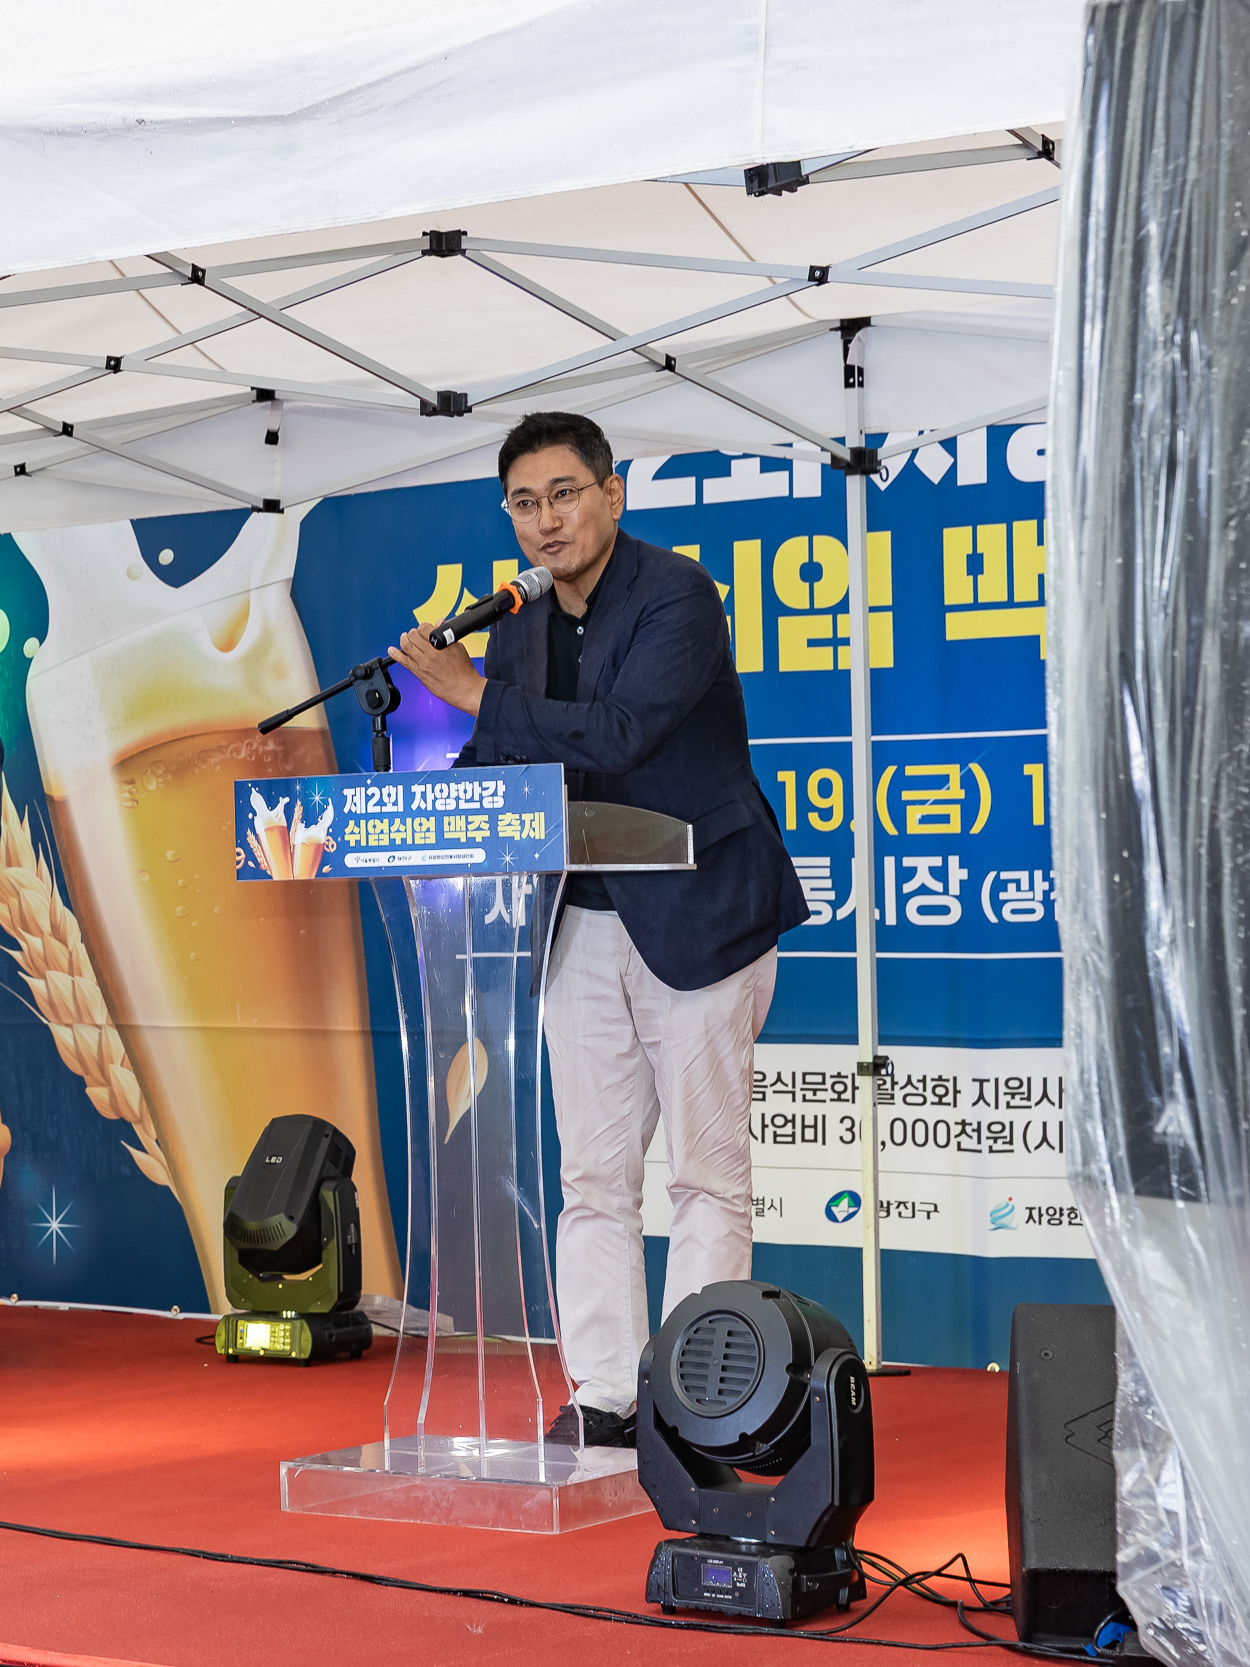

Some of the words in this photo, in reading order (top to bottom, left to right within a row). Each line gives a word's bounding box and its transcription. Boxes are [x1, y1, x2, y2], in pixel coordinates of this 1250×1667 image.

[343, 784, 404, 815] 제2회
[410, 780, 506, 812] 자양한강
[344, 816, 436, 848] 쉬엄쉬엄
[443, 814, 491, 843] 맥주
[497, 811, 546, 841] 축제
[265, 1156, 283, 1164] LED
[849, 1375, 857, 1406] BEAM
